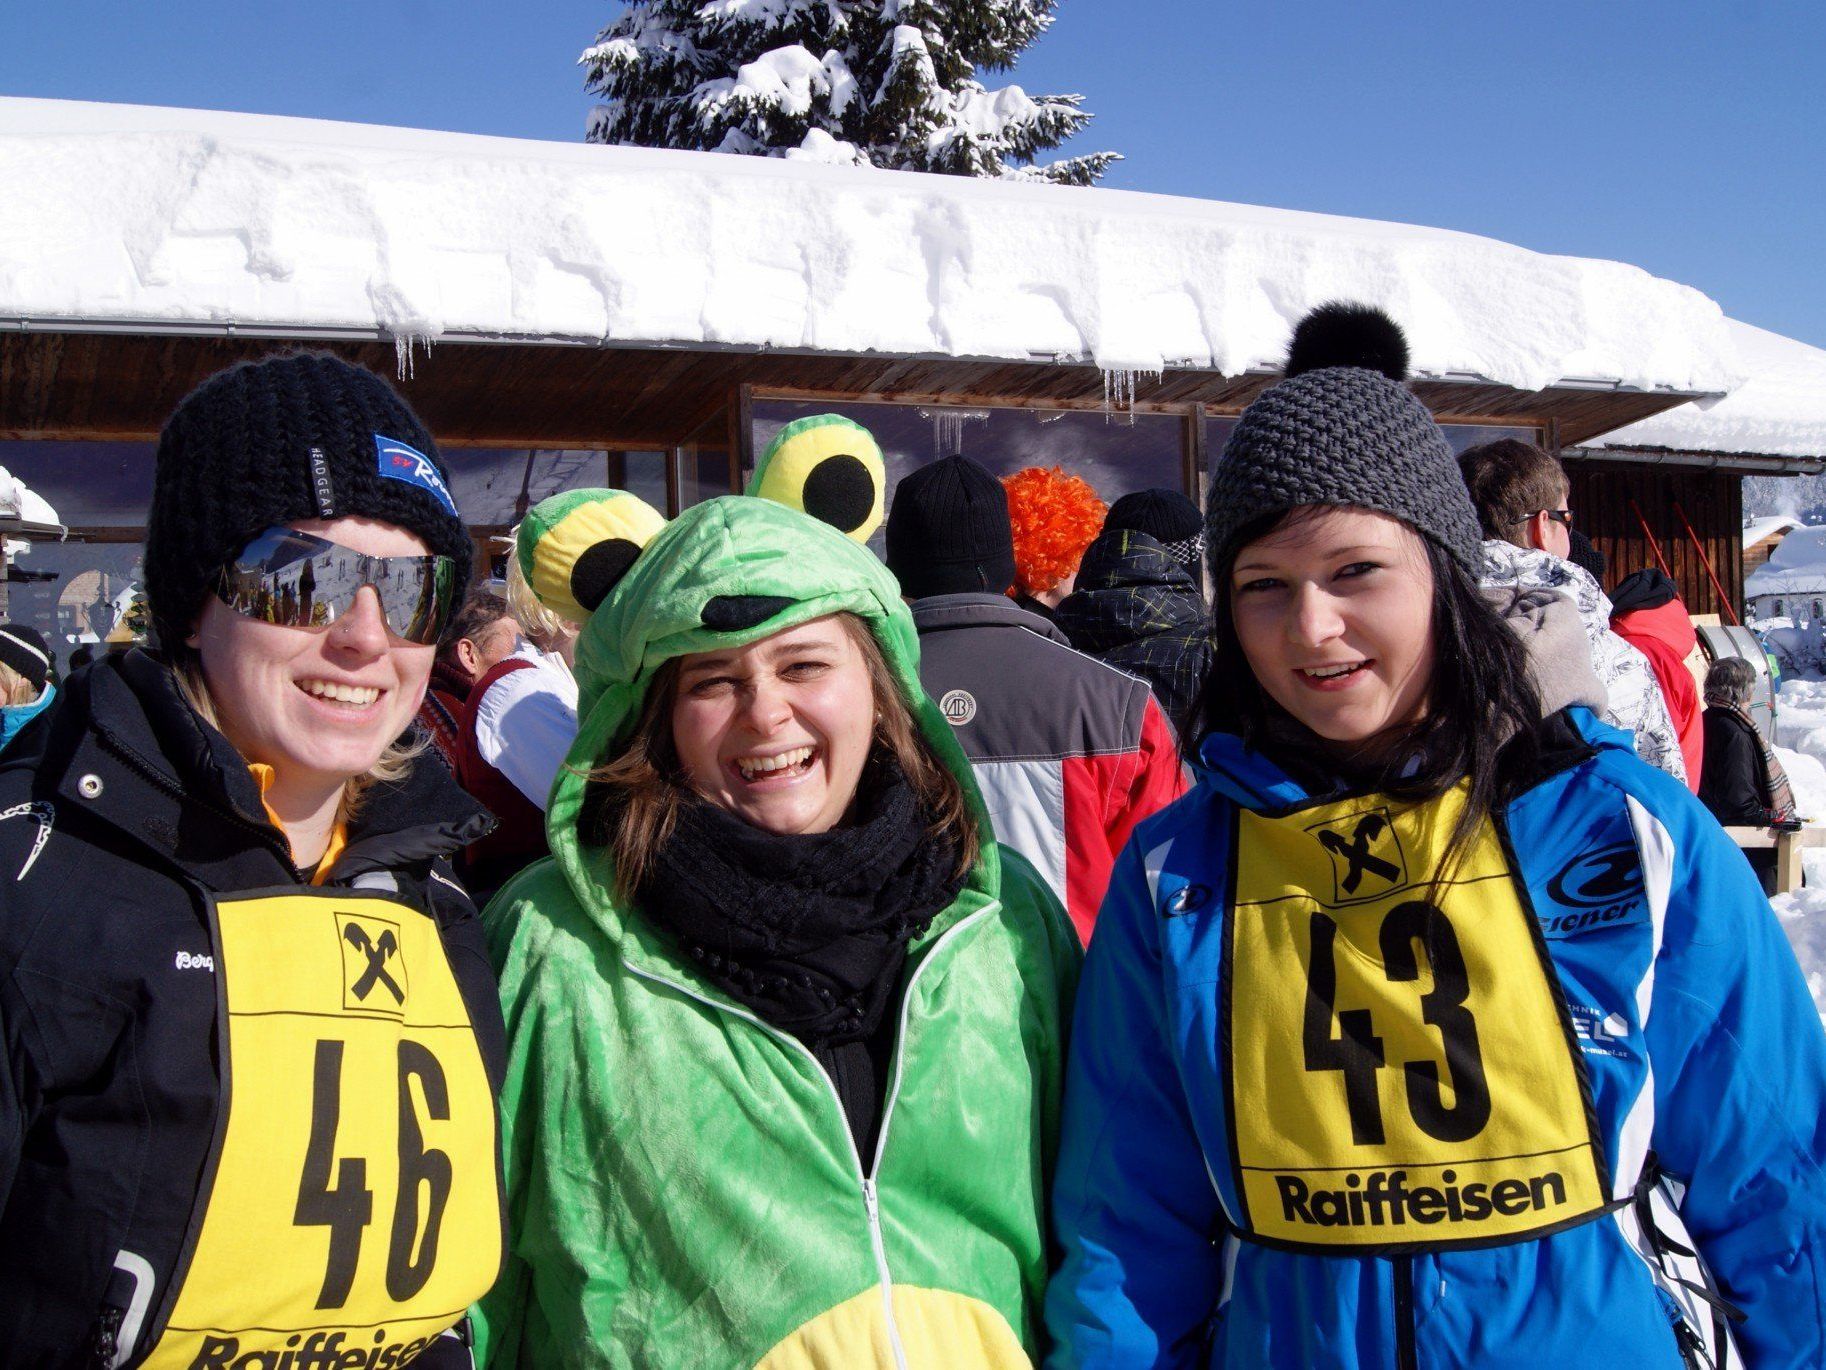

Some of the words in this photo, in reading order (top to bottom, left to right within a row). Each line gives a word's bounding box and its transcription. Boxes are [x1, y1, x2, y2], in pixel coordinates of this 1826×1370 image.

[311, 447, 334, 517] HEADGEAR
[1303, 901, 1492, 1146] 43
[293, 1039, 453, 1310] 46
[1275, 1170, 1567, 1227] Raiffeisen
